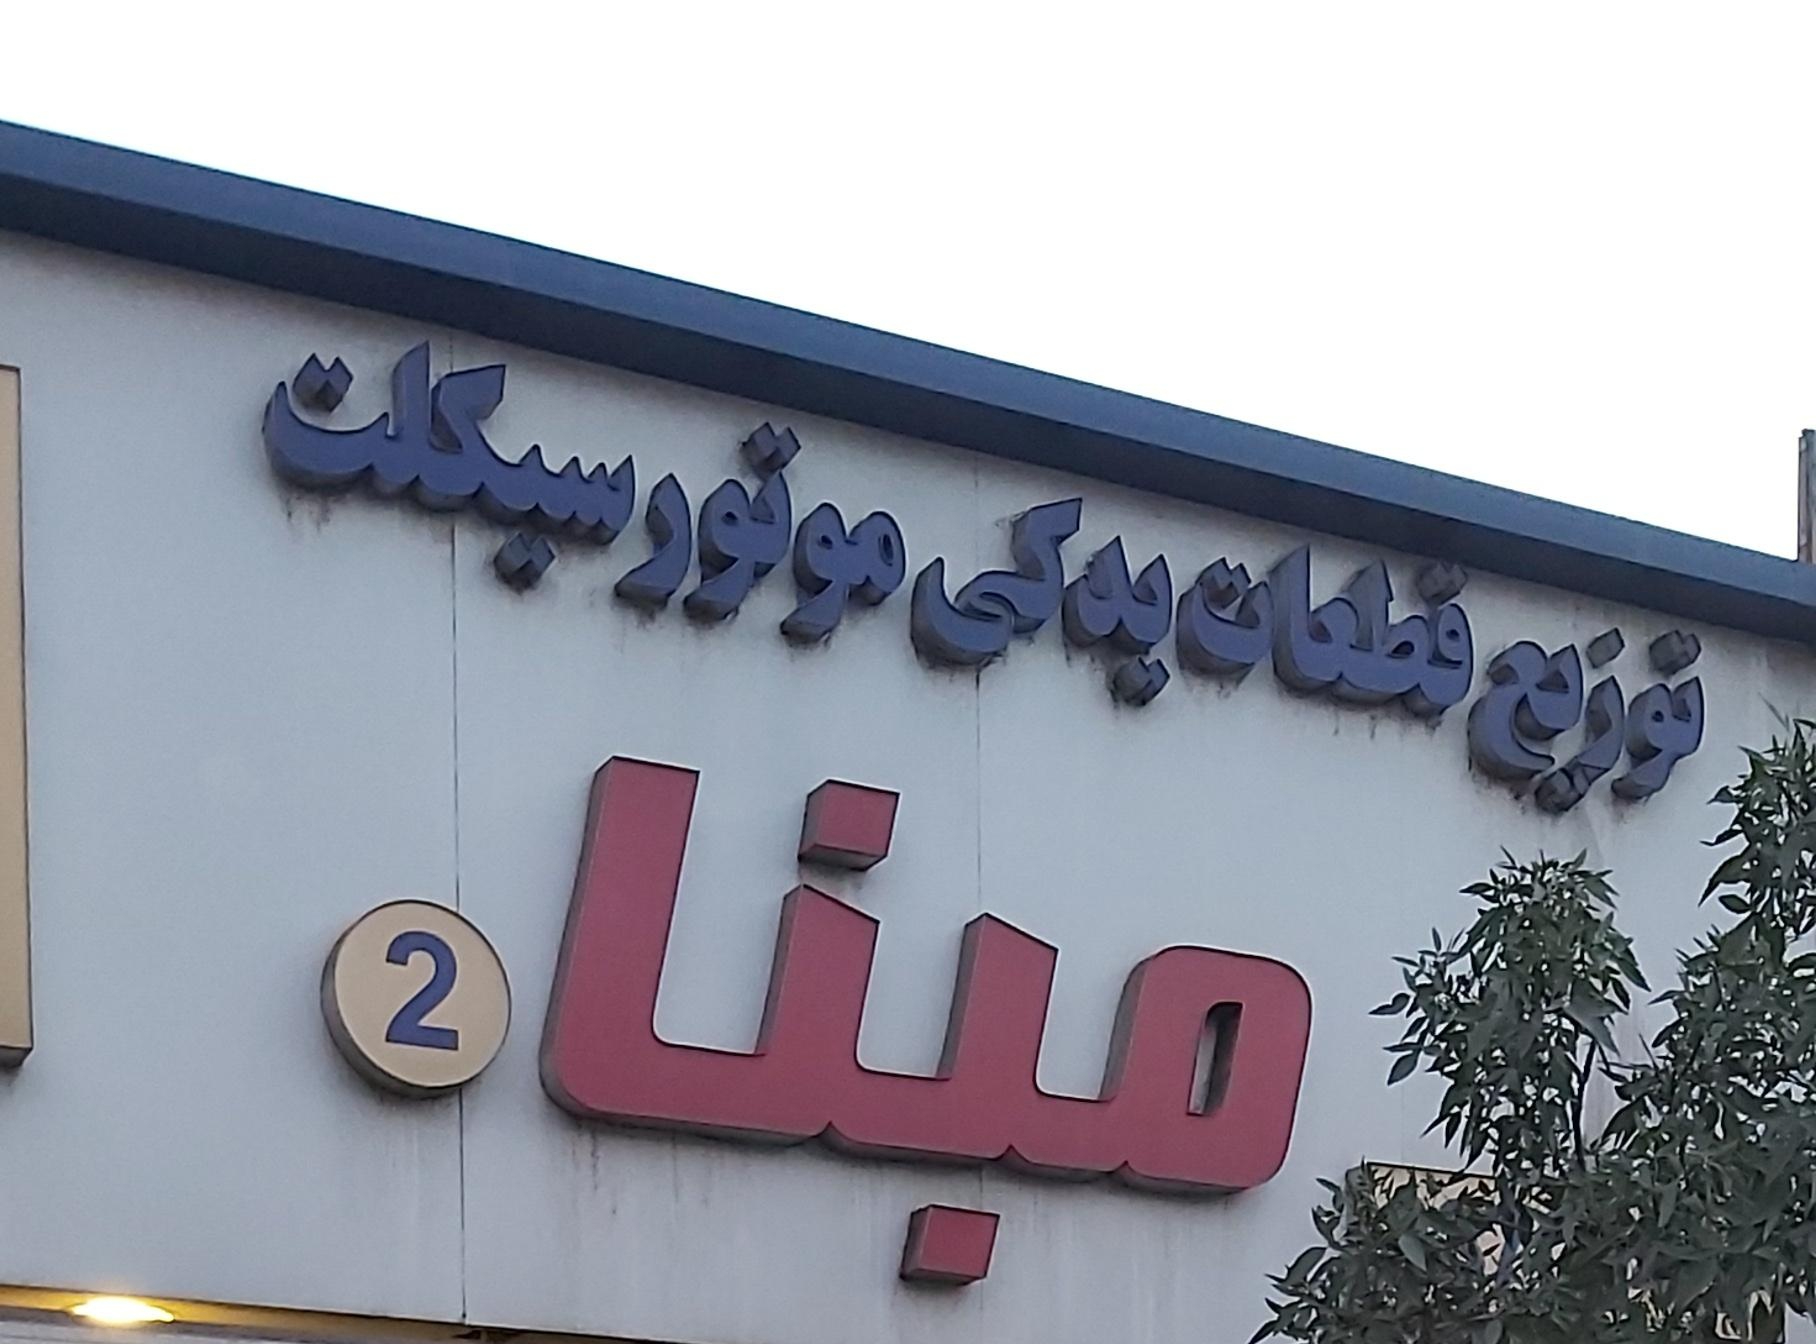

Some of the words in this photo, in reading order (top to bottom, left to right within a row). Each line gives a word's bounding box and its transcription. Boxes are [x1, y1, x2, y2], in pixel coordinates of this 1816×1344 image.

[262, 340, 636, 592] سیکلت
[612, 422, 906, 645] موتور
[911, 498, 1172, 708] یدکی
[1177, 545, 1475, 719] قطعات
[1469, 628, 1704, 813] توزیع
[385, 930, 460, 1051] 2
[540, 755, 1312, 1287] مبنا
